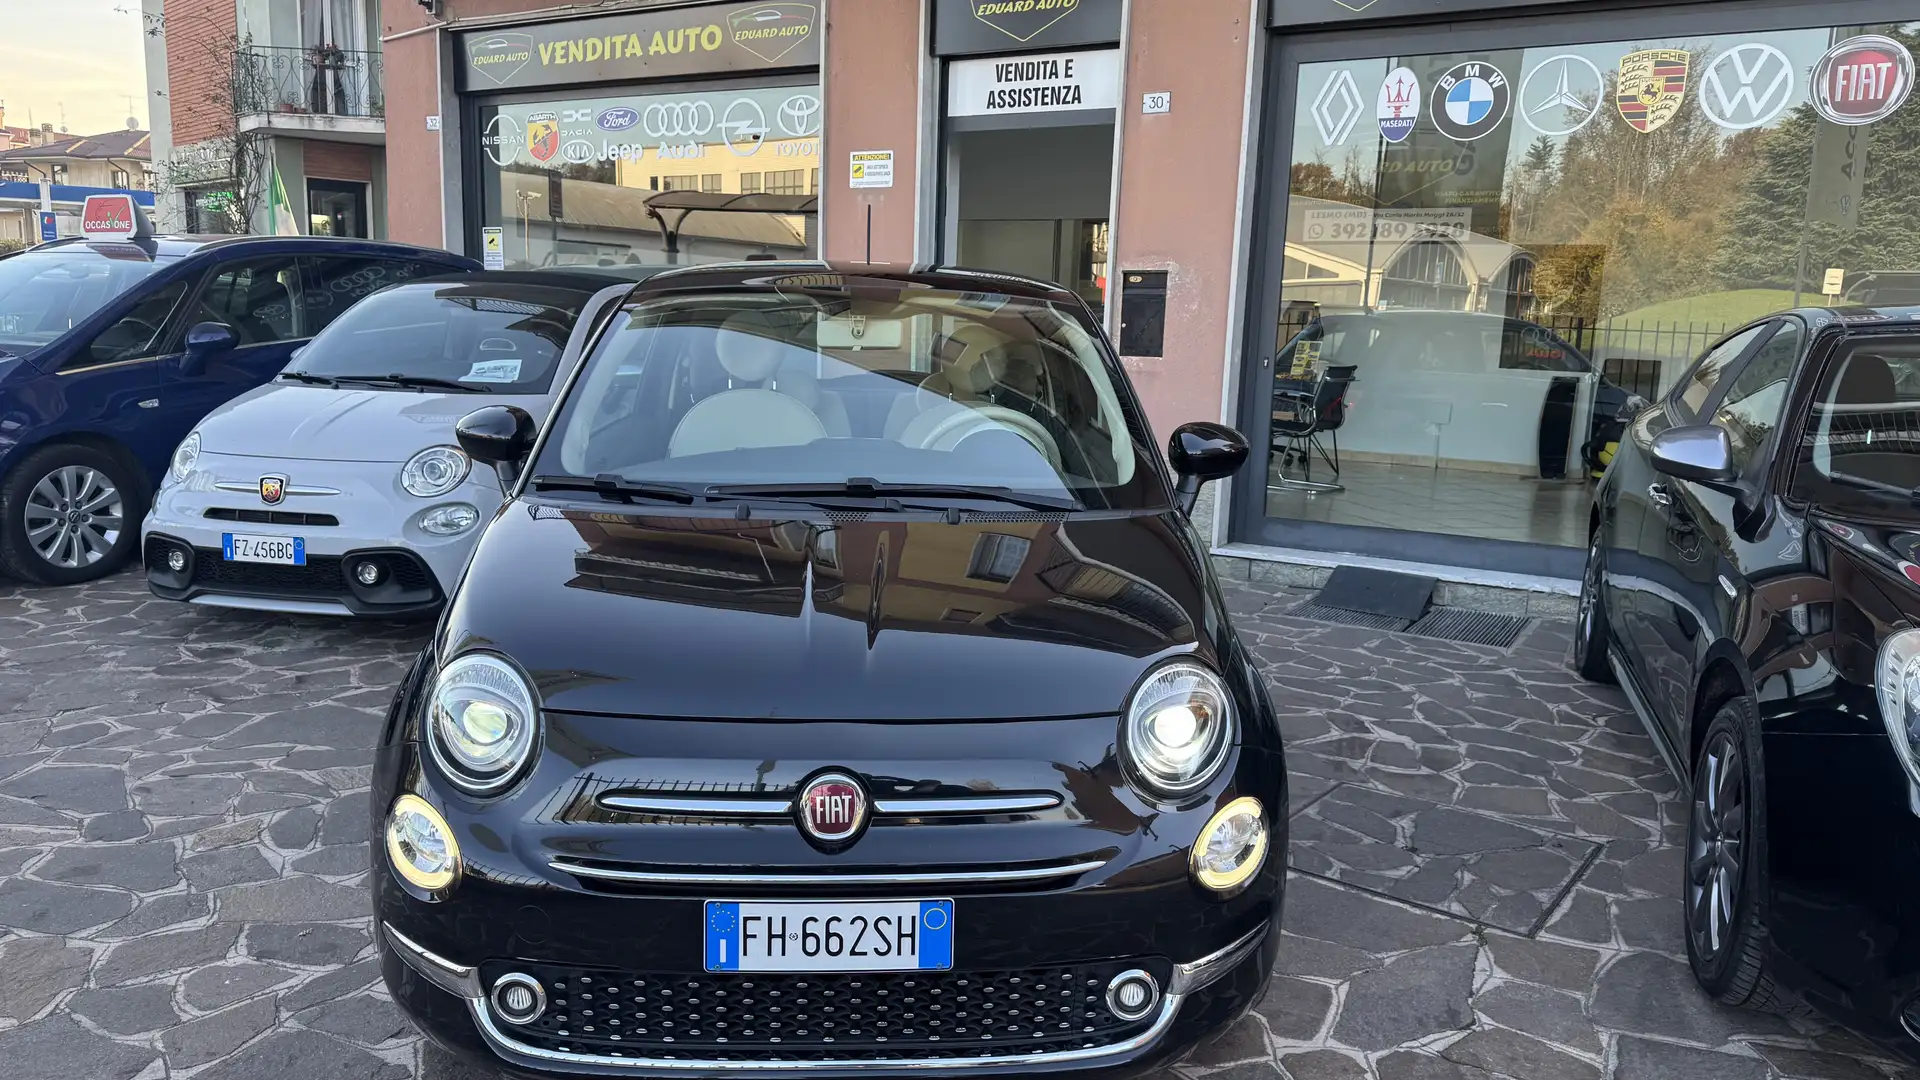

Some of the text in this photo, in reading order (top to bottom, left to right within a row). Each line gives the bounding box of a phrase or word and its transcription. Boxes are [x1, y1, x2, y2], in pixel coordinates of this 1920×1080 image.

[977, 0, 1075, 16] EDUARD AUTO
[735, 25, 809, 41] EDUARD AUTO
[538, 24, 723, 66] VENDITA AUTO
[473, 52, 529, 65] EDUARD AUTO
[1622, 52, 1687, 67] PORSCHE
[995, 58, 1074, 83] VENDITA E
[1440, 64, 1505, 91] BMW
[1834, 61, 1892, 102] FIAT
[986, 85, 1082, 109] ASSISTENZA
[1148, 96, 1164, 109] 30
[529, 112, 557, 122] ABARTH
[603, 110, 631, 128] Ford
[1380, 119, 1412, 128] MASERATI
[562, 128, 593, 136] DACIA
[482, 135, 525, 146] NISSAN
[567, 146, 590, 159] KIA
[597, 139, 643, 164] Jeep
[656, 140, 705, 160] Audi
[775, 142, 819, 157] TOYOT
[1330, 222, 1367, 238] 392
[815, 794, 852, 824] FIAT
